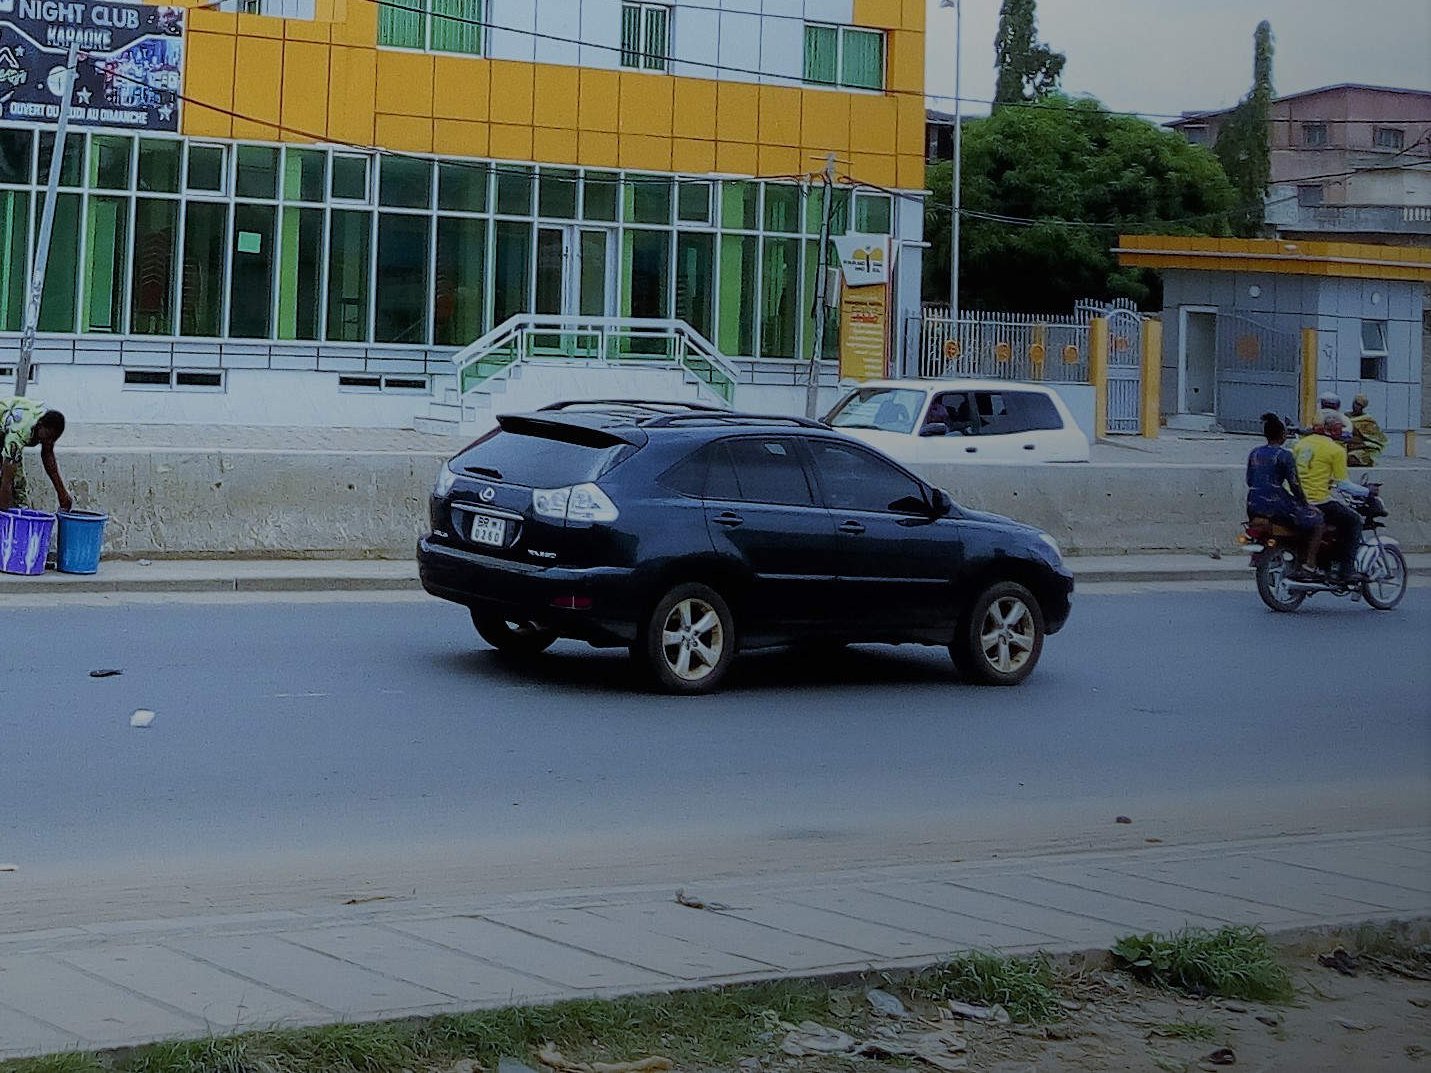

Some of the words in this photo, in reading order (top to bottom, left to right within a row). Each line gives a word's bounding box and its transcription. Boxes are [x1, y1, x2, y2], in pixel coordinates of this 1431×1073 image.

[19, 0, 85, 24] NIGHT
[91, 6, 140, 29] CLUB
[47, 26, 112, 50] KARAOKE
[101, 110, 147, 125] DIMANCHE
